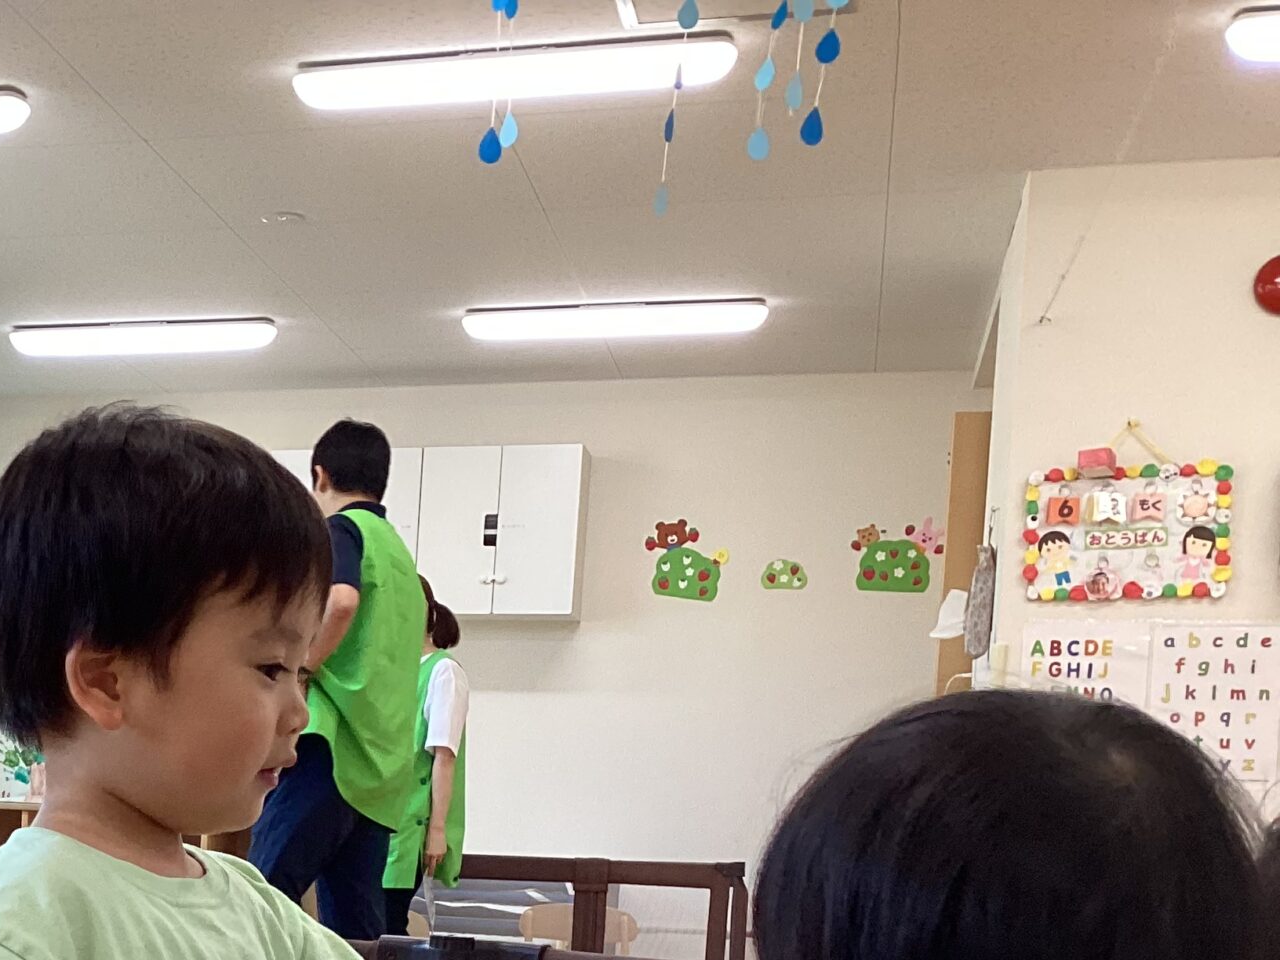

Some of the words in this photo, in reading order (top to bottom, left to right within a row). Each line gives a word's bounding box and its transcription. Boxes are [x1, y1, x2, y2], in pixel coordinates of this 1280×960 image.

[1058, 499, 1074, 518] 6
[1139, 499, 1163, 511] もく
[1088, 532, 1164, 546] おとうばん
[1164, 636, 1176, 648] a
[1188, 632, 1201, 648] b
[1213, 636, 1224, 648] c
[1236, 633, 1249, 648] d
[1260, 636, 1272, 648] e
[1175, 657, 1186, 674] f
[1198, 661, 1210, 676] g
[1224, 659, 1235, 674] h
[1250, 659, 1257, 674] i
[1161, 683, 1171, 704] j
[1185, 684, 1196, 700] k
[1230, 689, 1246, 701] m
[1259, 689, 1270, 701] n
[1170, 712, 1181, 723] o
[1194, 711, 1205, 727] p
[1220, 712, 1231, 727] q
[1245, 712, 1257, 725] r
[1219, 738, 1231, 749] u
[1244, 738, 1256, 749] v
